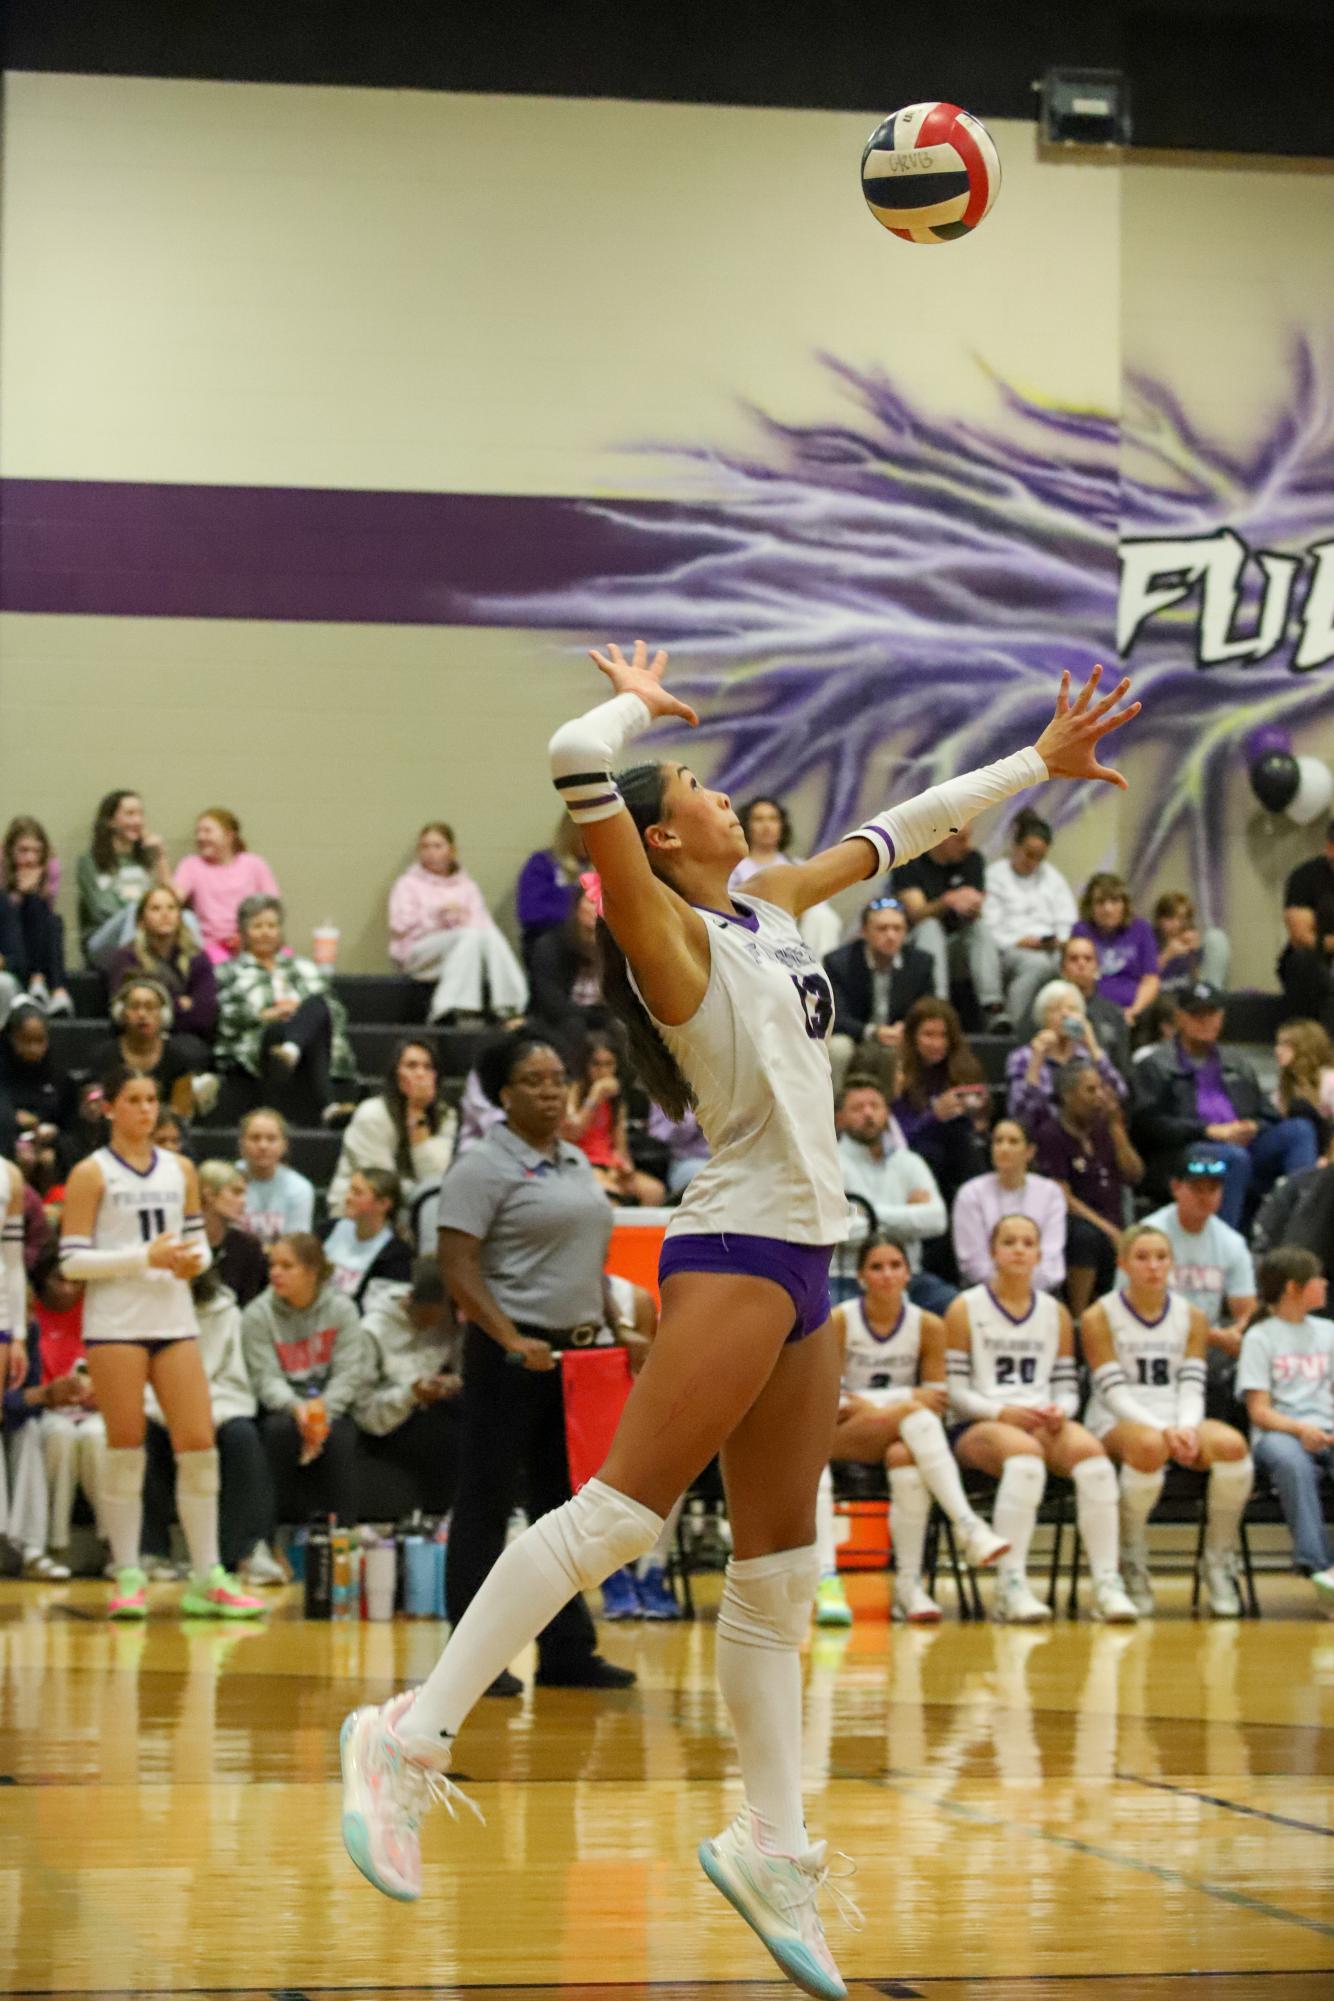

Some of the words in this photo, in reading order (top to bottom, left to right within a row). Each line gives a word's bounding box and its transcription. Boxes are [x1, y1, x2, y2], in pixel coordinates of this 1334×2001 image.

[788, 973, 833, 1040] 13
[138, 1208, 166, 1242] 11
[995, 1355, 1037, 1385] 20
[1136, 1357, 1170, 1386] 18
